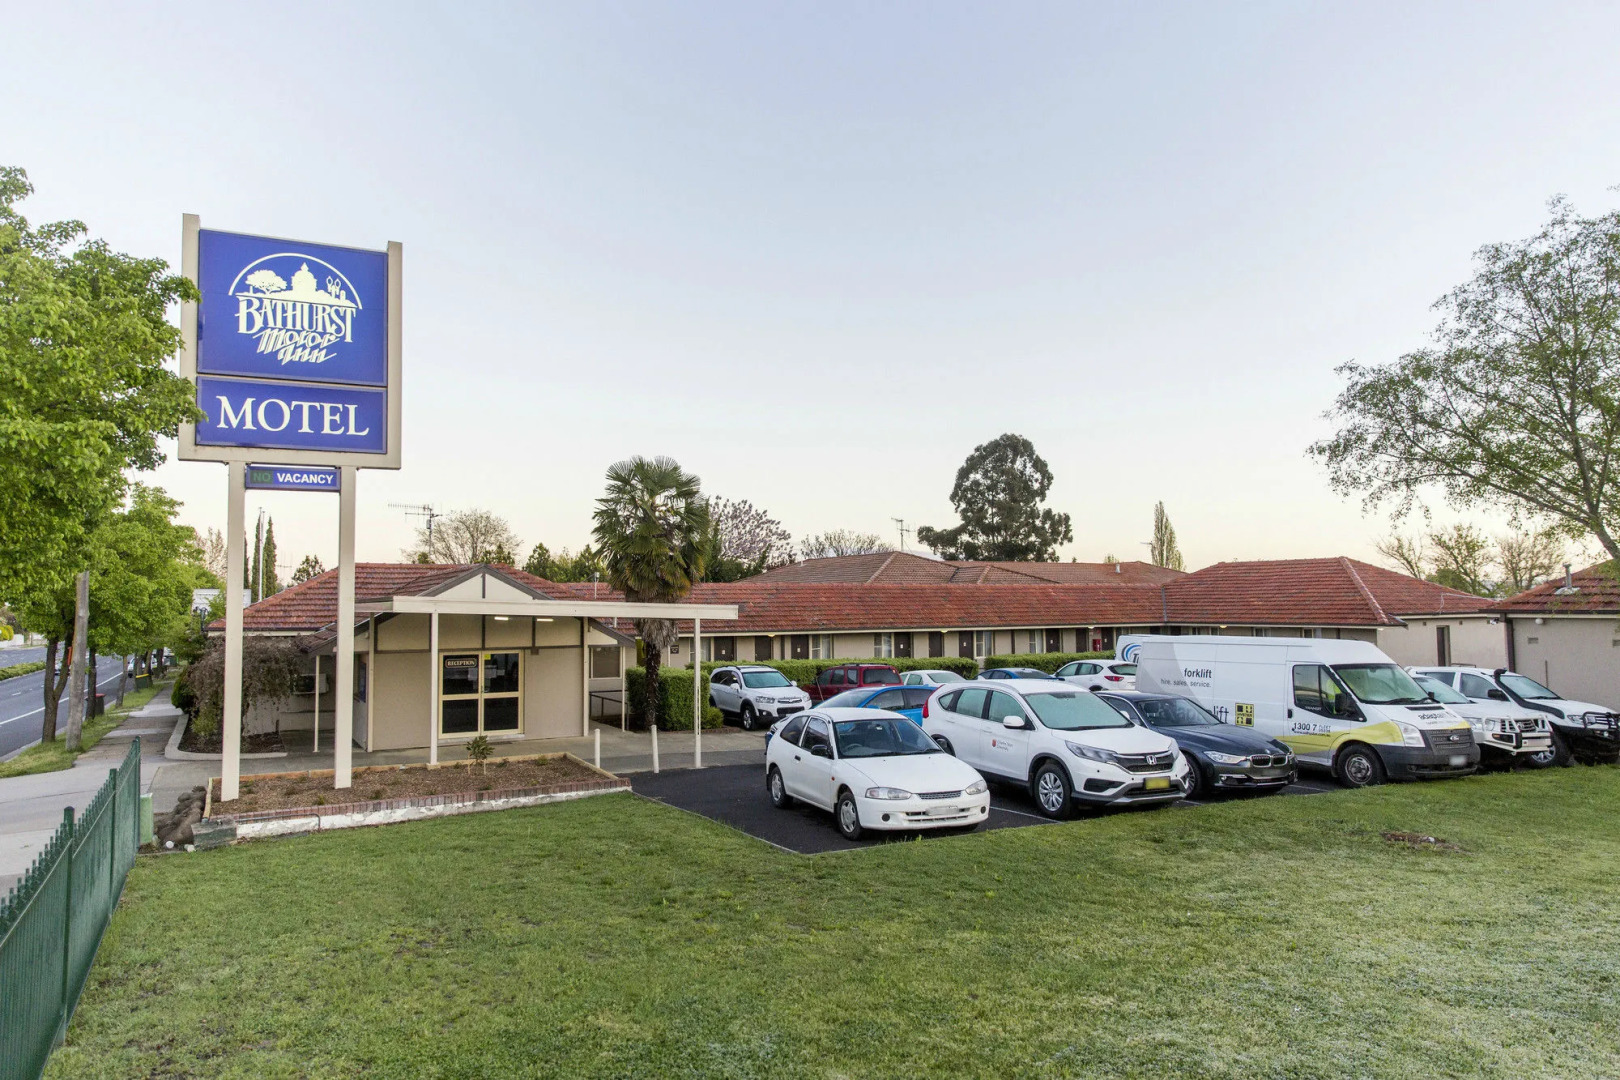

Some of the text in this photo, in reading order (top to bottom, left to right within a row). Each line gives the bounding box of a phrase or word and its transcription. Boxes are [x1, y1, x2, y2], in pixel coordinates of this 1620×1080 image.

[235, 296, 356, 343] BATHURST
[253, 328, 340, 354] Motor
[277, 343, 337, 366] Inn
[216, 395, 369, 436] MOTEL
[253, 472, 334, 485] NO VACANCY
[1184, 667, 1212, 679] forklift
[1293, 722, 1311, 731] 1300
